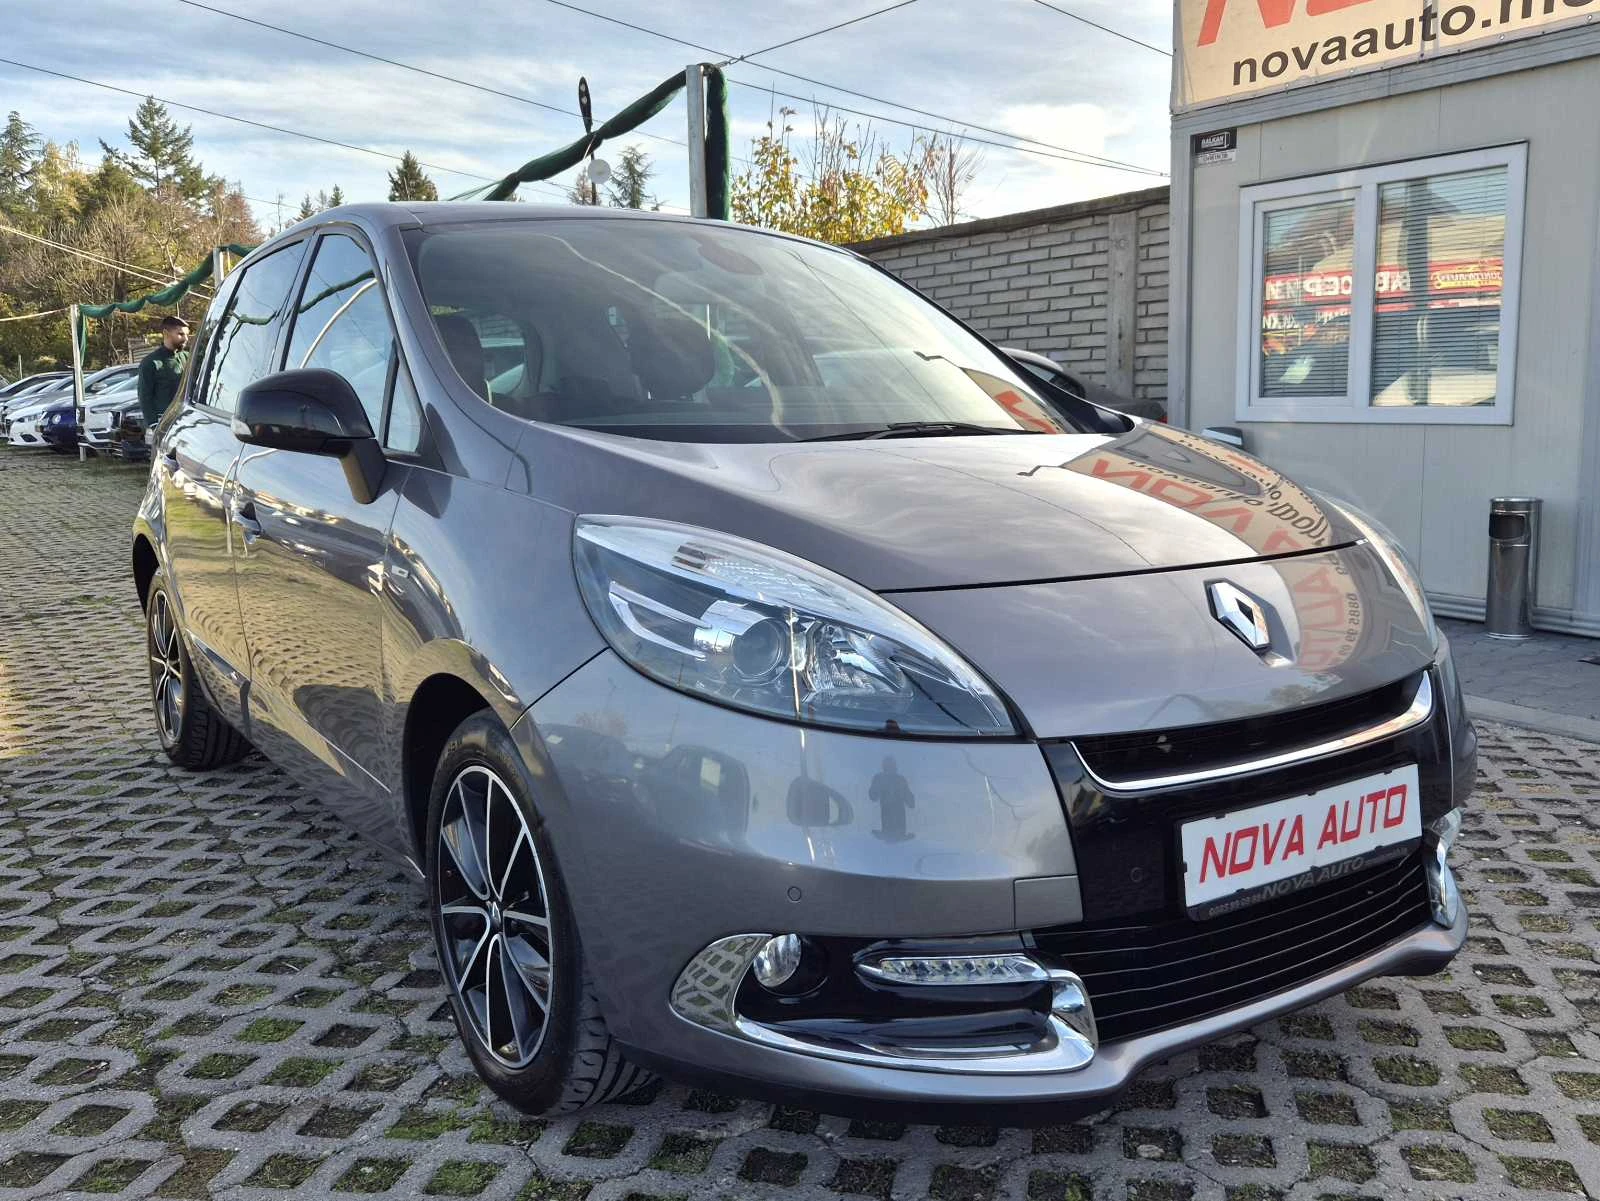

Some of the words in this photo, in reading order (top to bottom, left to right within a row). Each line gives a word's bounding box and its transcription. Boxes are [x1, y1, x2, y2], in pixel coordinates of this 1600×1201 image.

[1232, 0, 1595, 86] novaauto.m
[1200, 815, 1304, 882] NOVA
[1317, 785, 1407, 849] AUTO
[1264, 879, 1315, 899] NOVA
[1318, 858, 1363, 880] AUTO
